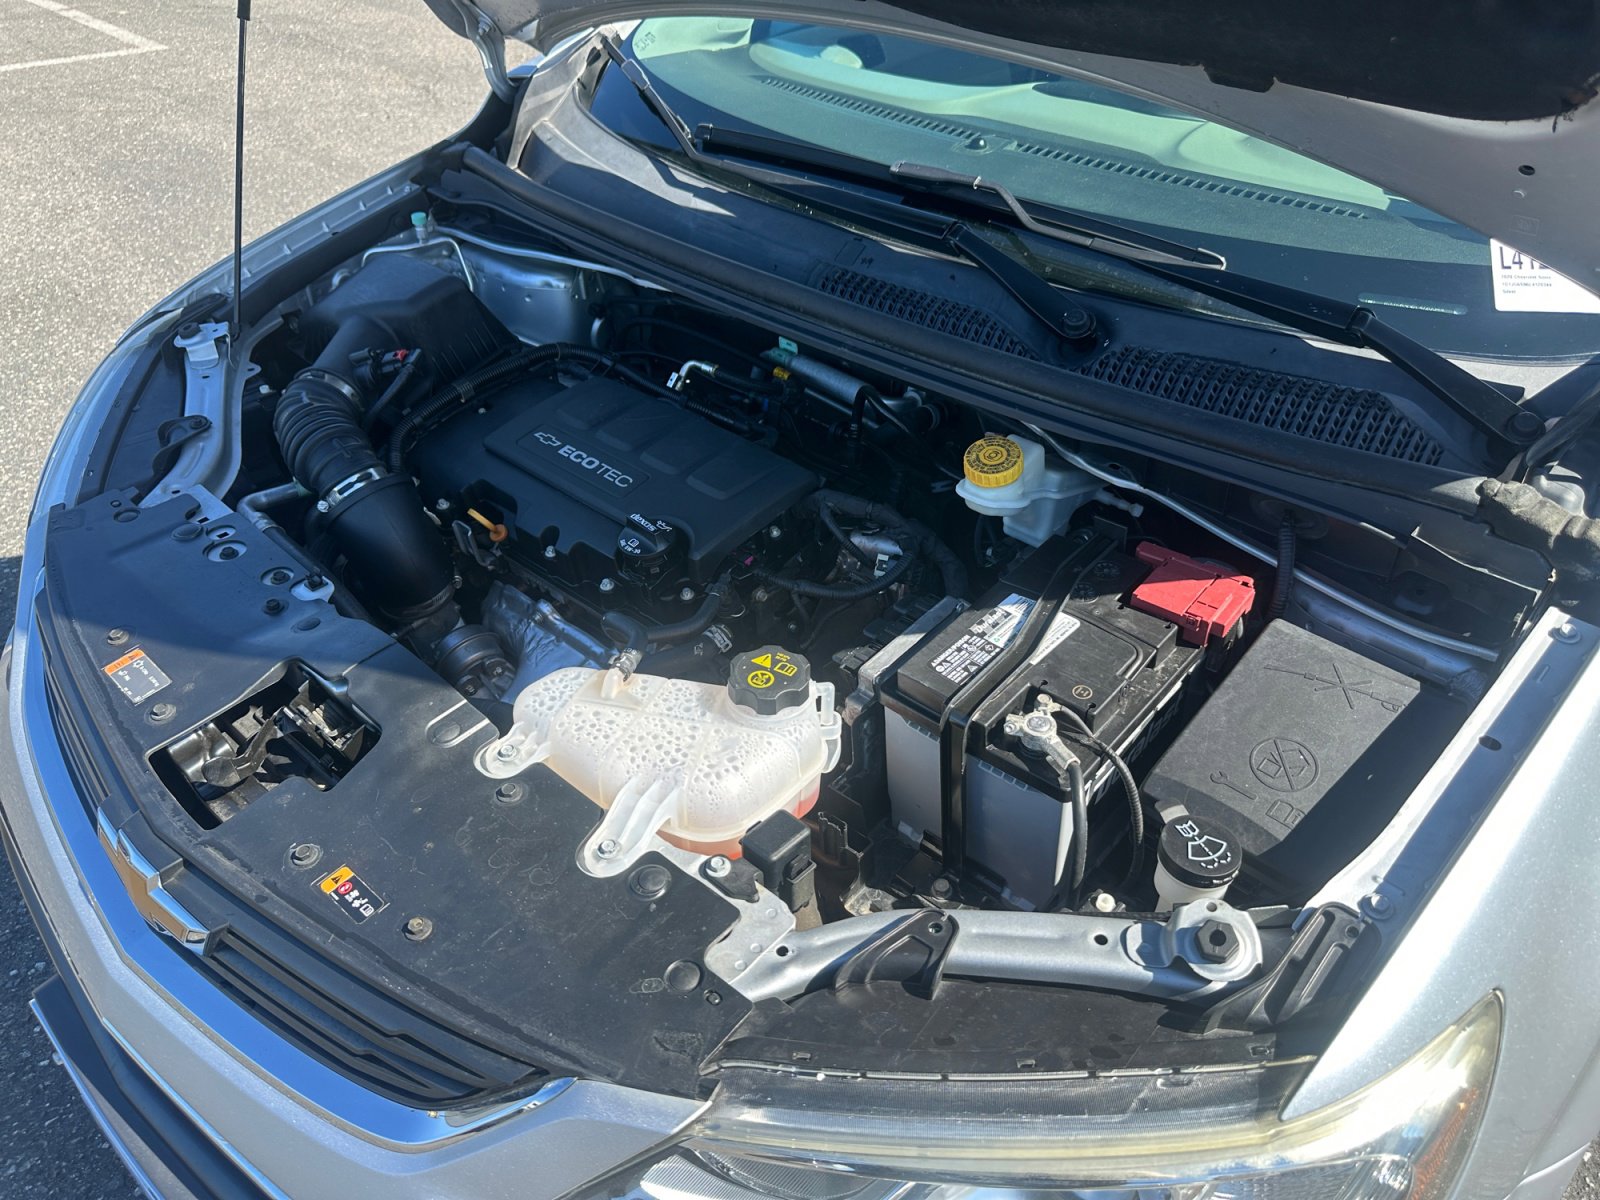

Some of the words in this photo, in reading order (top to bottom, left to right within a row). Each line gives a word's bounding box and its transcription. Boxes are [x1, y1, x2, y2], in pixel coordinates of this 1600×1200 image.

[1499, 246, 1551, 270] L4
[557, 445, 633, 488] ECOTEC
[630, 513, 656, 531] dexos
